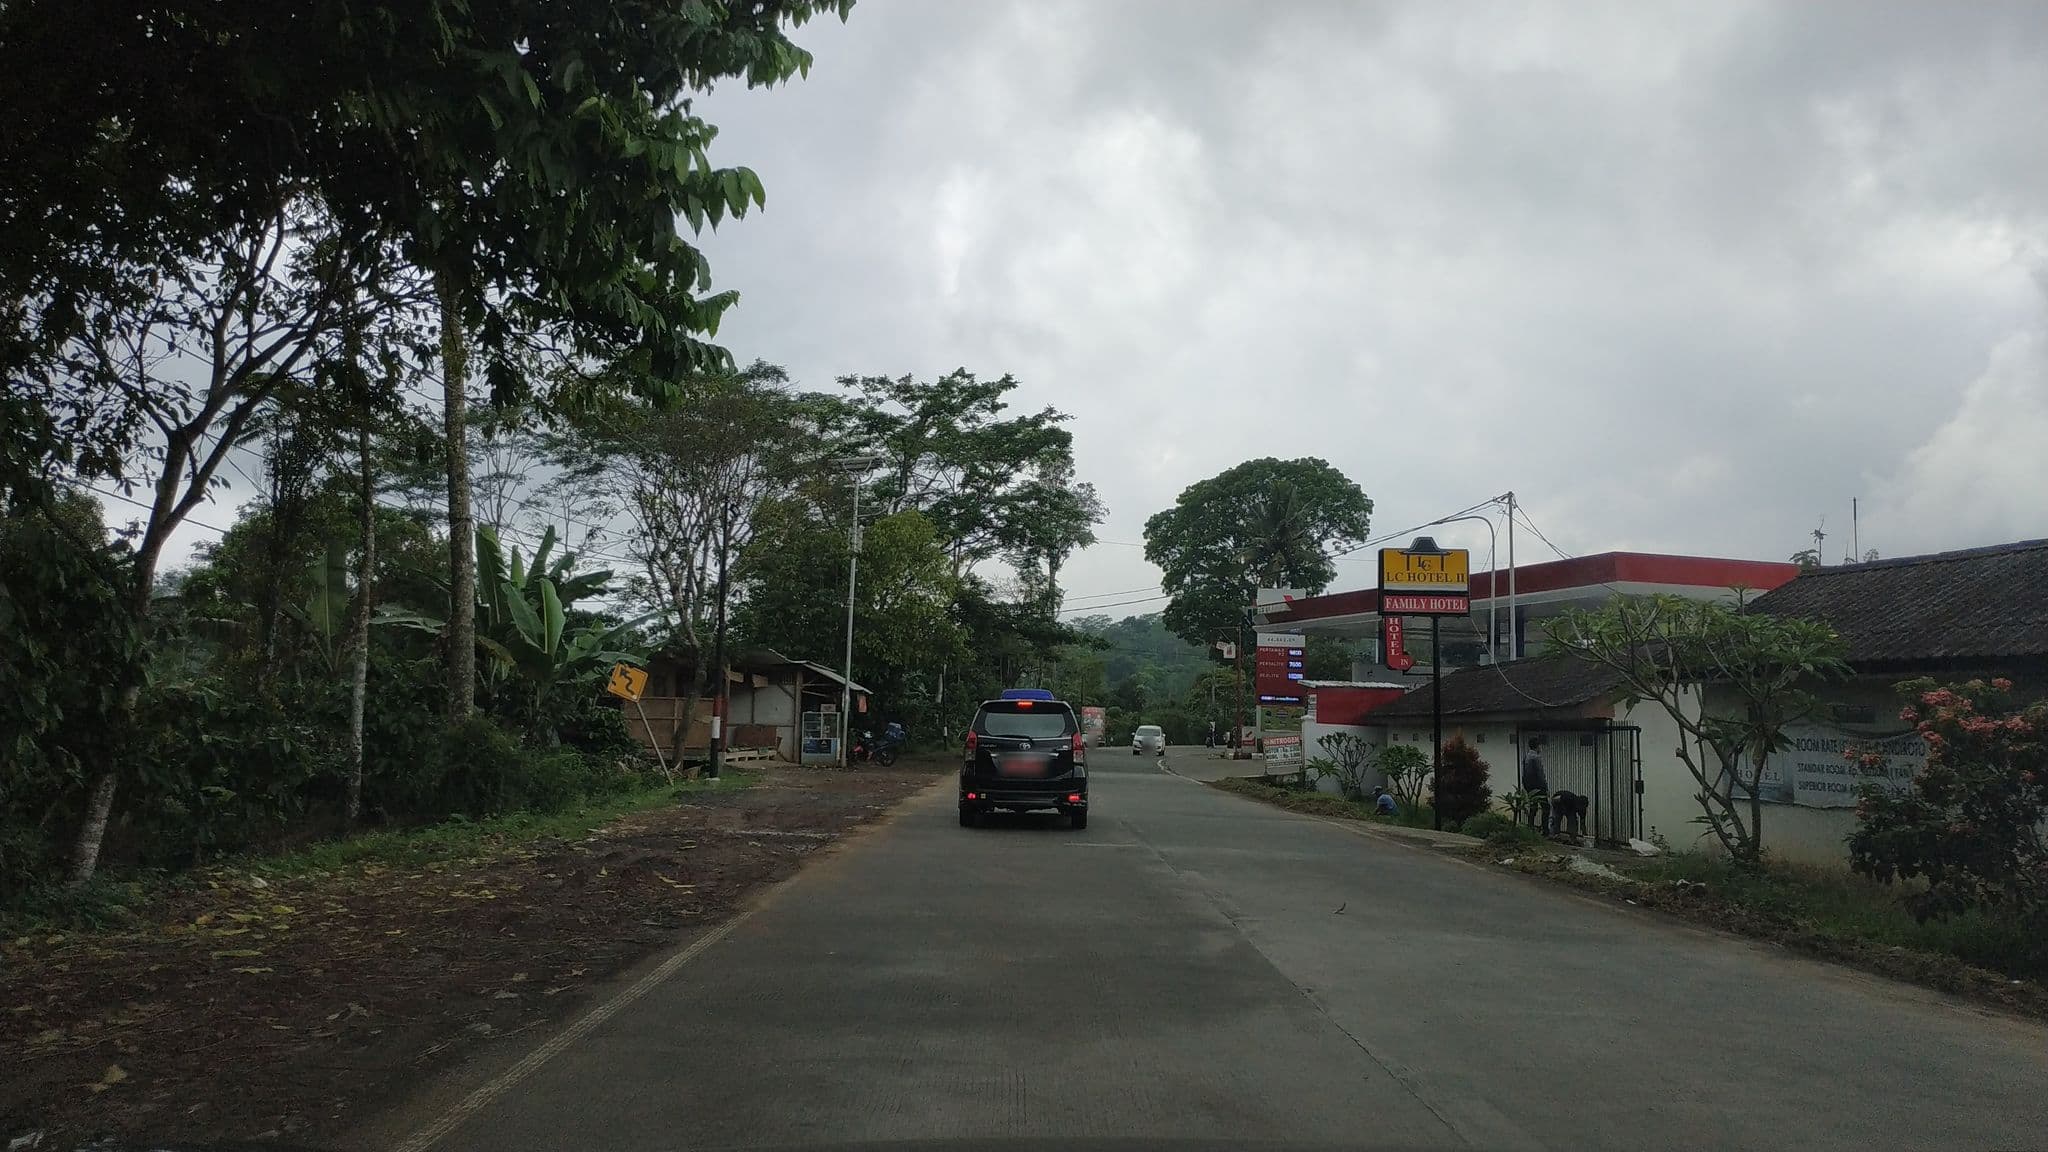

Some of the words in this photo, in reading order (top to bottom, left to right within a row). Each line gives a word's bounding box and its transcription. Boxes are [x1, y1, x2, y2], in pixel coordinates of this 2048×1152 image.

[1386, 572, 1404, 582] LC
[1407, 571, 1453, 583] HOTEL
[1456, 571, 1465, 583] II
[1385, 596, 1427, 609] FAMILY
[1429, 598, 1467, 610] HOTEL
[1388, 617, 1400, 656] HOTEL
[1821, 738, 1838, 753] RATE
